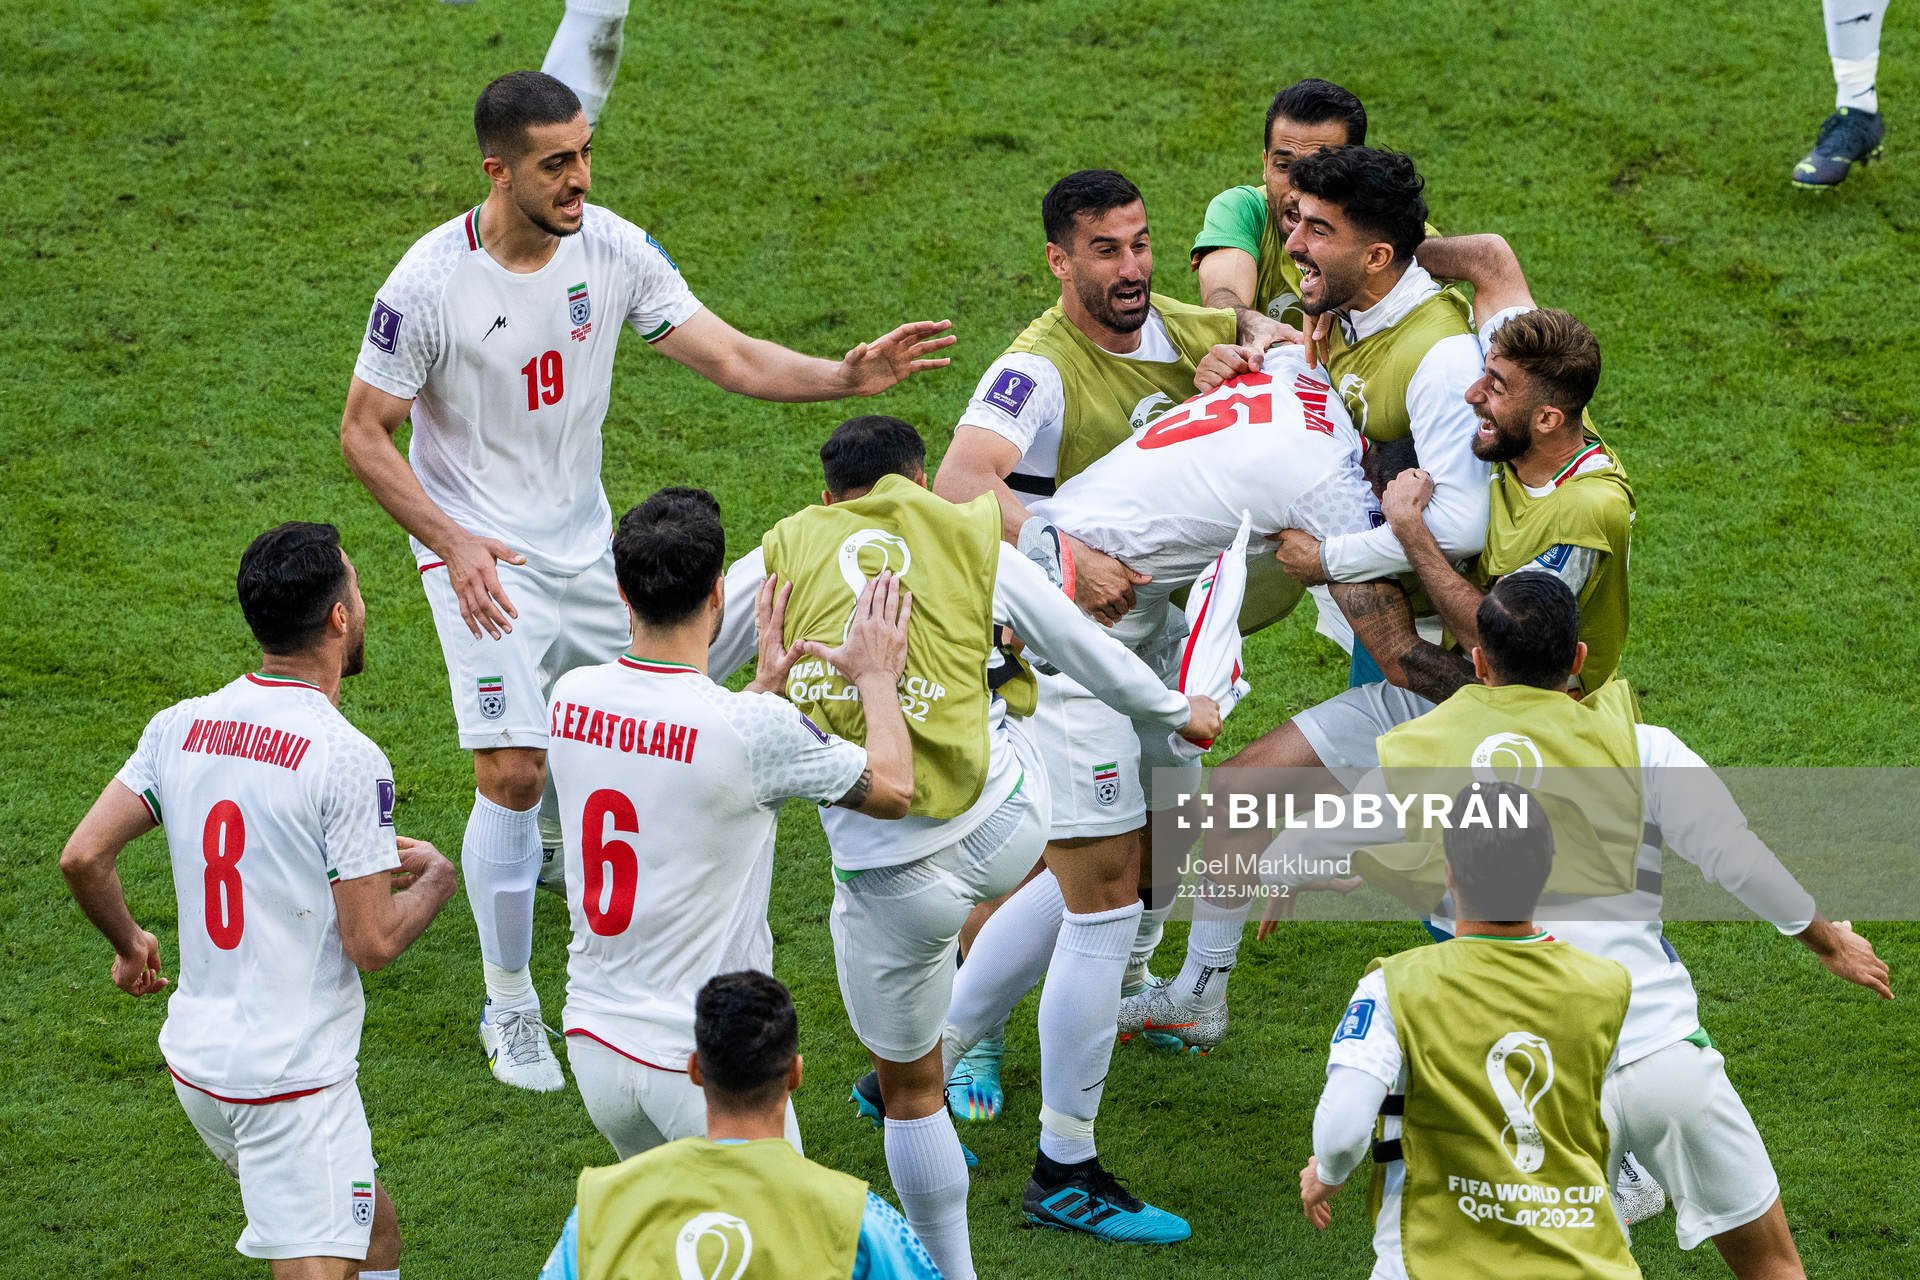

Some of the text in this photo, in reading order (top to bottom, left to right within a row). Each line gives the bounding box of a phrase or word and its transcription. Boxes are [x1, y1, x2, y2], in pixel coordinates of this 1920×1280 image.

[521, 350, 564, 411] 19
[907, 676, 945, 701] CUP
[551, 701, 698, 764] S.EZATOLAHI
[203, 799, 245, 950] 8
[582, 788, 639, 936] 6
[1448, 1175, 1605, 1204] FIFA WORLD CUP
